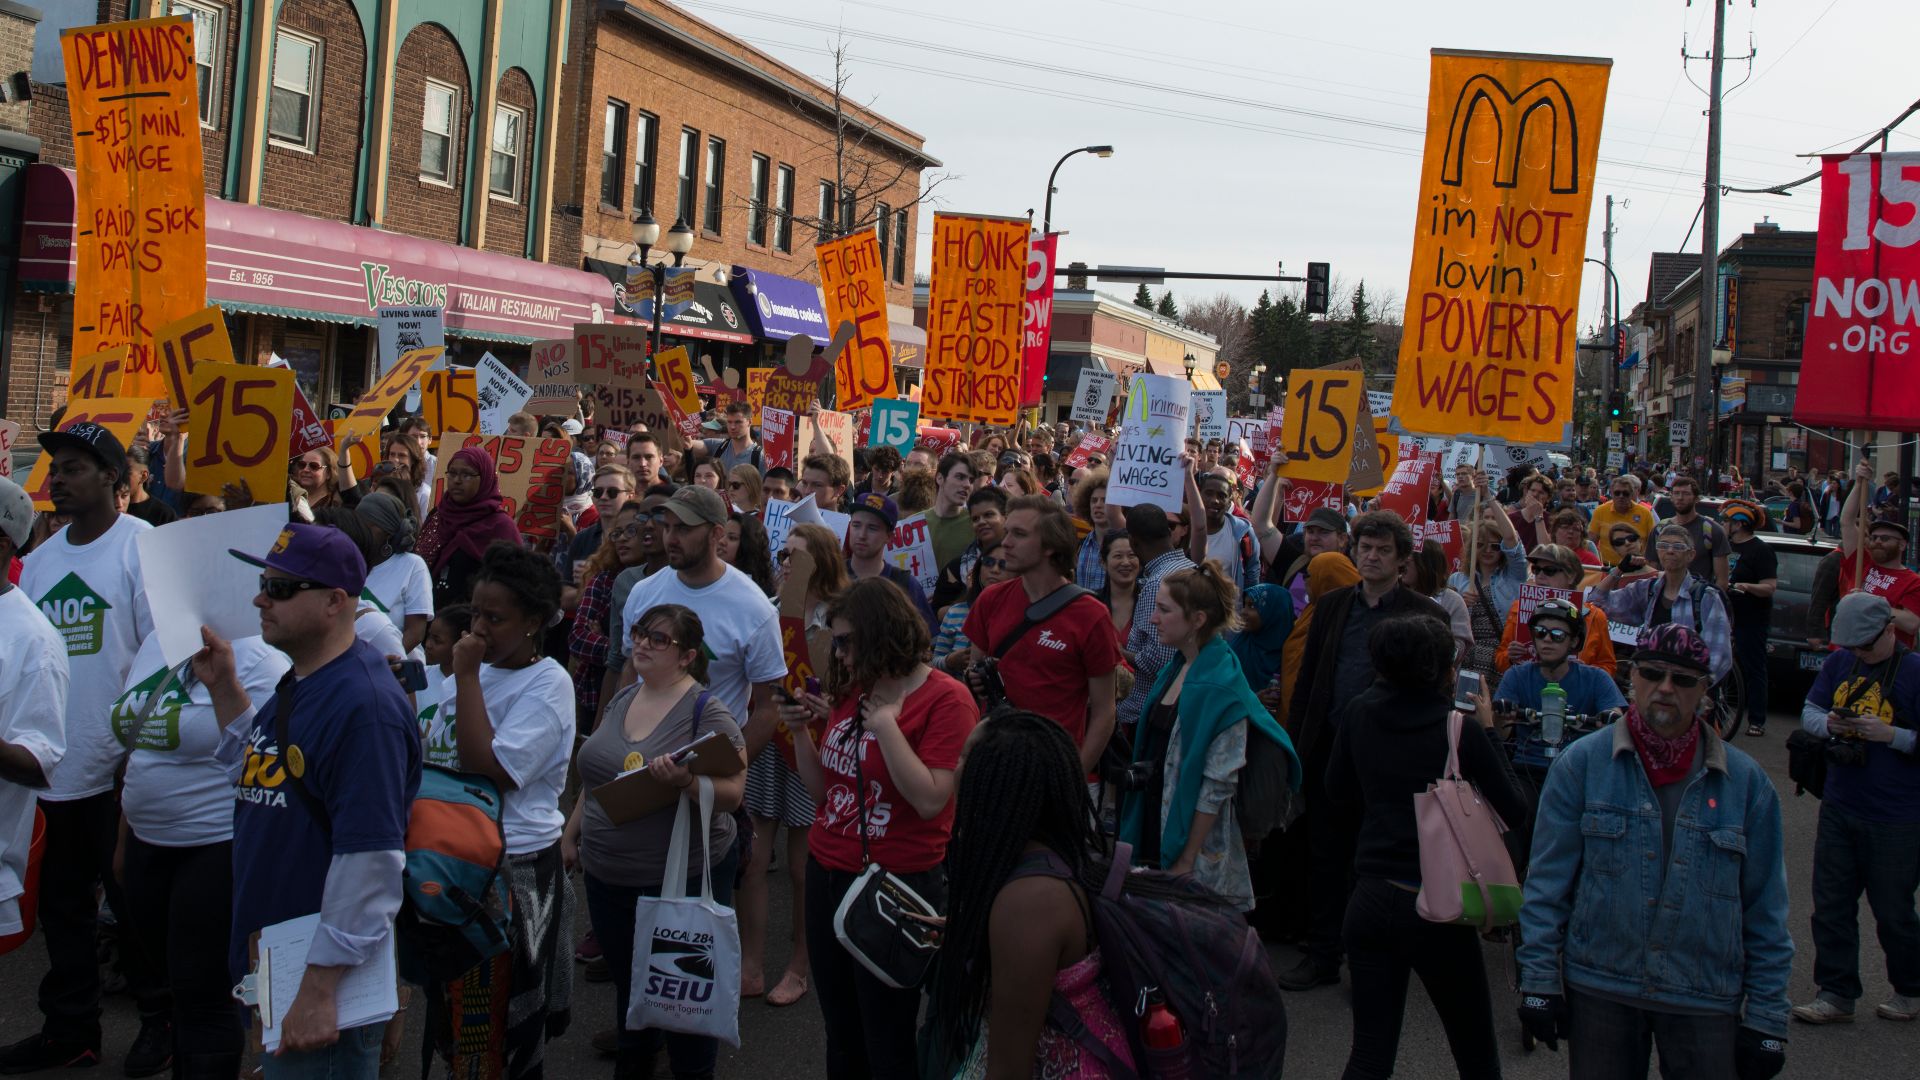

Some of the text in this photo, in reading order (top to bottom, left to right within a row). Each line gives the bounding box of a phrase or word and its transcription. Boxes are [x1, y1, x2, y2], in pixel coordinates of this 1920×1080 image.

[74, 25, 193, 91] DEMANDS:
[108, 145, 172, 173] WAGE
[1432, 194, 1573, 254] i'm NOT
[101, 239, 163, 272] DAYS
[822, 237, 877, 282] FIGHT
[945, 226, 1024, 272] HONK
[1027, 235, 1048, 292] 5
[1436, 246, 1537, 296] lovin'
[229, 269, 274, 287] Est. 1956
[965, 278, 997, 297] FOR
[457, 293, 561, 321] ITALIAN RESTAURANT
[837, 279, 875, 313] FOR
[1814, 276, 1920, 326] NOW
[381, 310, 438, 318] LIVING WAGE
[398, 321, 421, 330] NOW!
[770, 300, 823, 323] insomnia cookies
[939, 298, 1016, 335] FAST
[1024, 297, 1051, 329] OW
[1417, 292, 1573, 364] POVERTY
[1829, 324, 1911, 355] .ORG
[536, 343, 566, 371] NO
[837, 310, 890, 407] $15
[939, 334, 1010, 370] FOOD
[483, 357, 528, 398] LIVING WAGE
[544, 361, 570, 379] NOS
[660, 359, 688, 399] 15
[1082, 369, 1099, 377] LIVING
[488, 376, 509, 397] NOW!
[1416, 356, 1559, 426] WAGES
[427, 373, 479, 440] 15
[765, 393, 790, 409] FOR
[193, 376, 278, 467] 15
[611, 410, 669, 430] UNION
[807, 411, 845, 430] FGHTING
[876, 408, 911, 446] 15
[1075, 413, 1092, 421] LOCAL
[1286, 380, 1349, 460] 15
[1672, 422, 1688, 430] ONE
[298, 421, 322, 442] 15
[1672, 429, 1688, 437] WAY
[1116, 443, 1176, 466] IVING
[1411, 460, 1426, 474] THE
[518, 438, 572, 539] RIGHTS
[1119, 466, 1168, 488] WAGES
[1322, 497, 1342, 511] 15
[887, 519, 928, 551] NOT
[1521, 585, 1573, 600] RAISE THE
[42, 595, 96, 625] NOC
[119, 690, 179, 718] NC
[821, 747, 858, 778] WAGE
[235, 785, 288, 808] NESOTA
[653, 926, 714, 944] LOCAL 284
[645, 975, 714, 1002] SEIU
[644, 997, 713, 1016] Stronger Together
